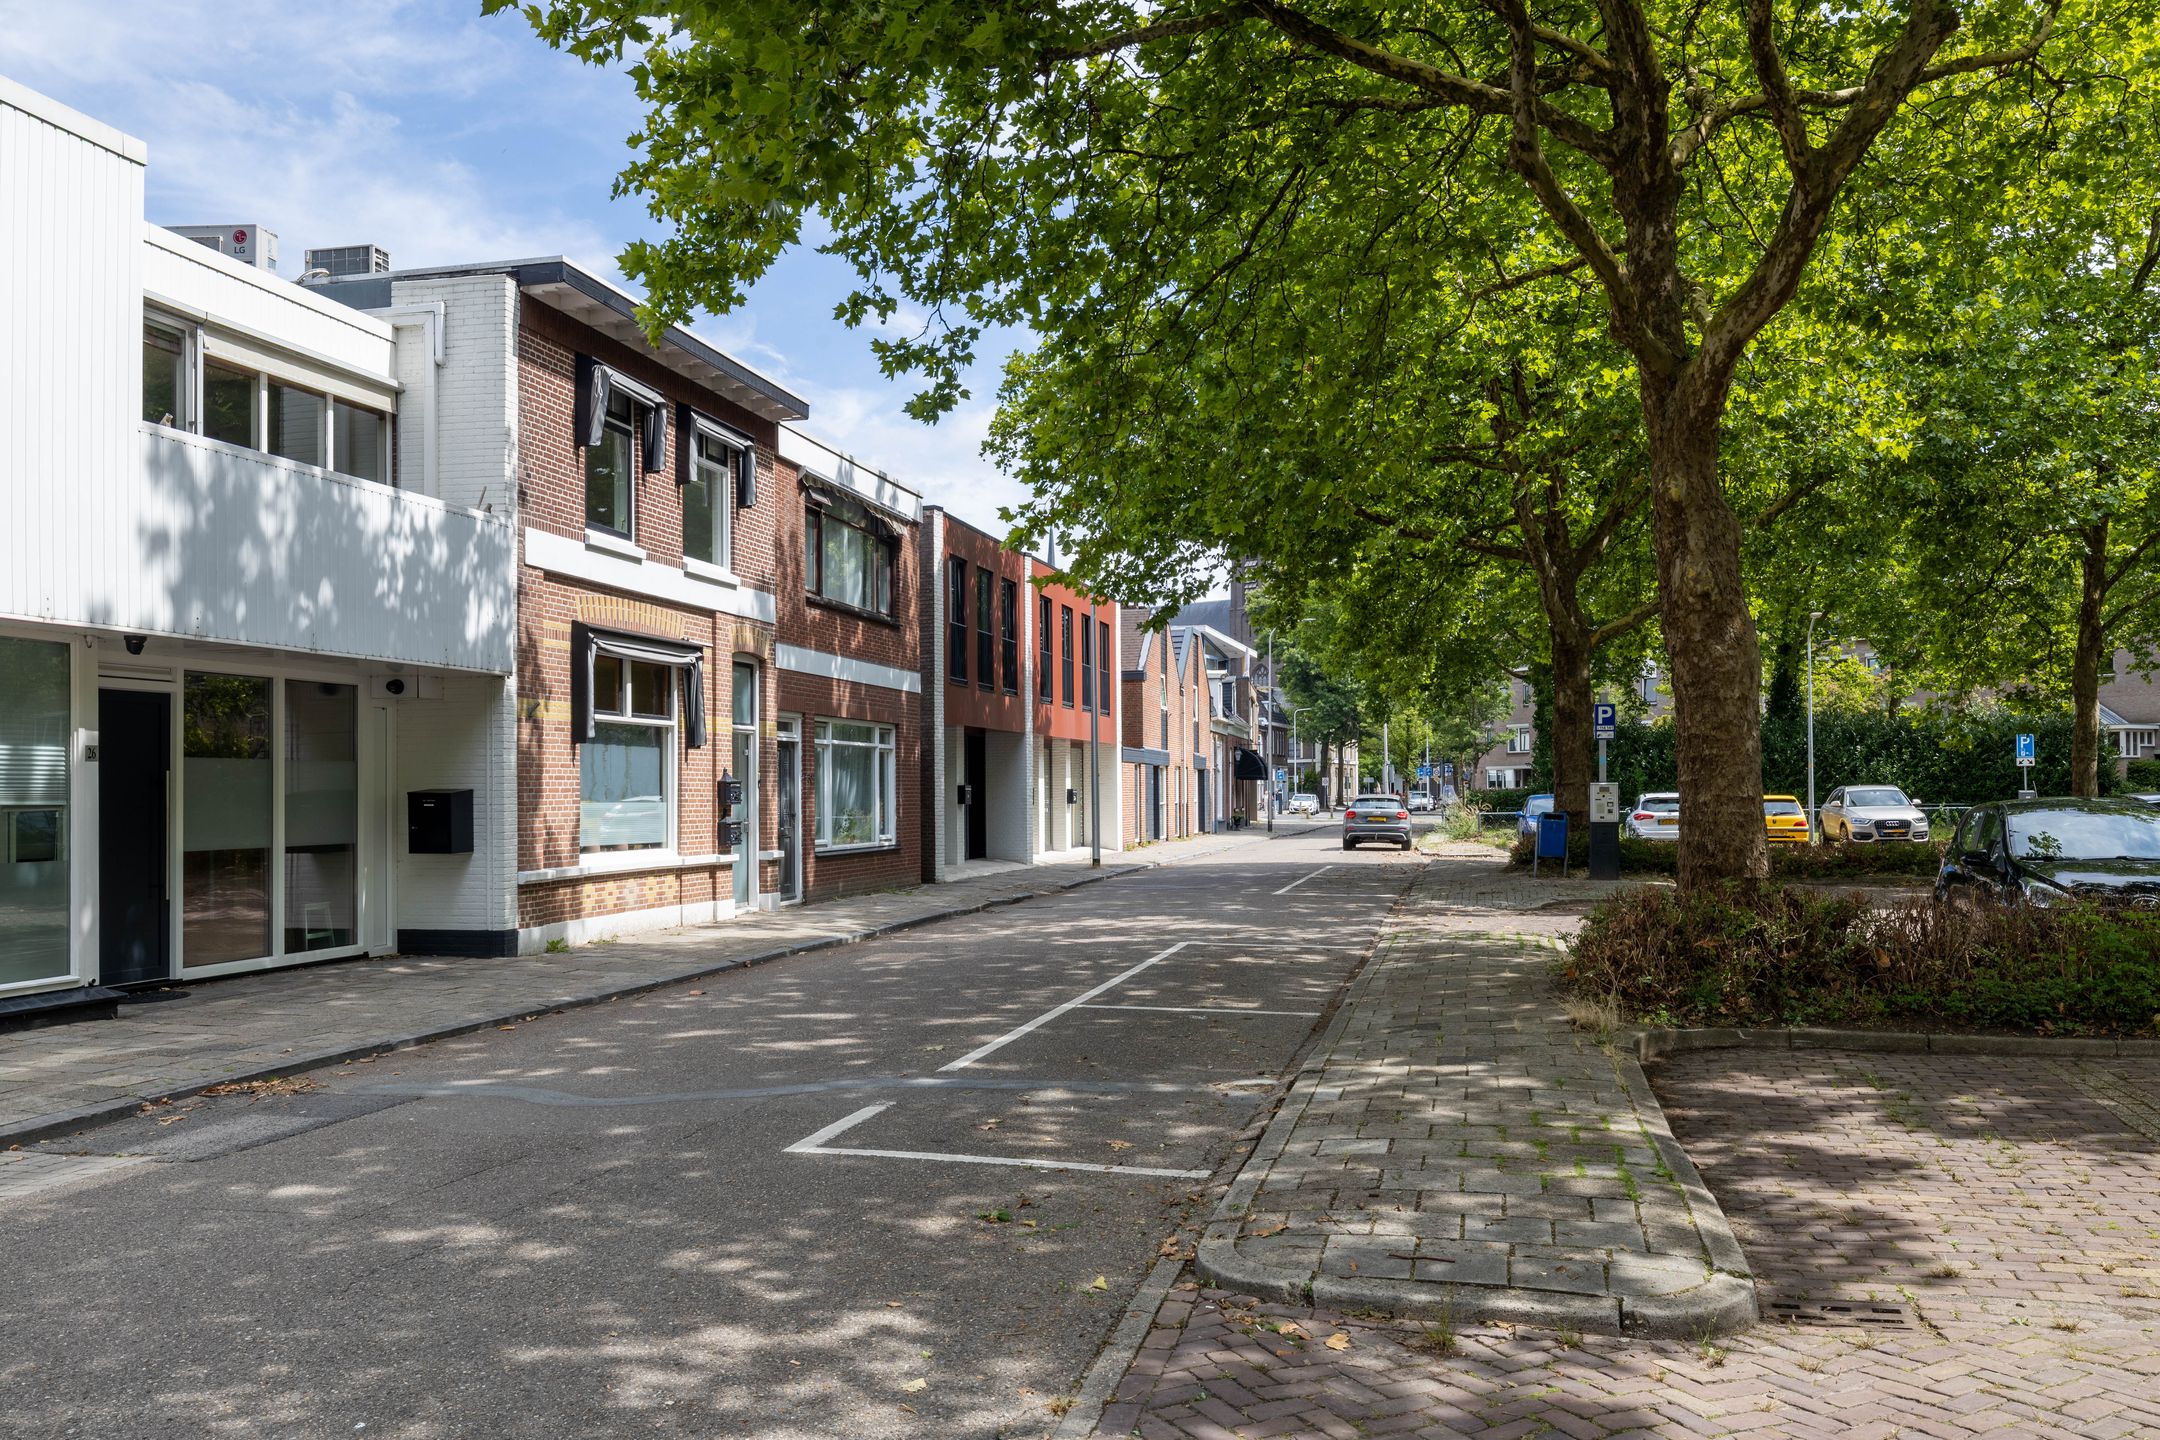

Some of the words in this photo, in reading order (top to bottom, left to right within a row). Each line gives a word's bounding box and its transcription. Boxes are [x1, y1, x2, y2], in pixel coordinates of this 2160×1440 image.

[234, 246, 246, 254] LG
[1598, 706, 1612, 724] P
[2021, 736, 2030, 749] P
[88, 747, 97, 760] 26
